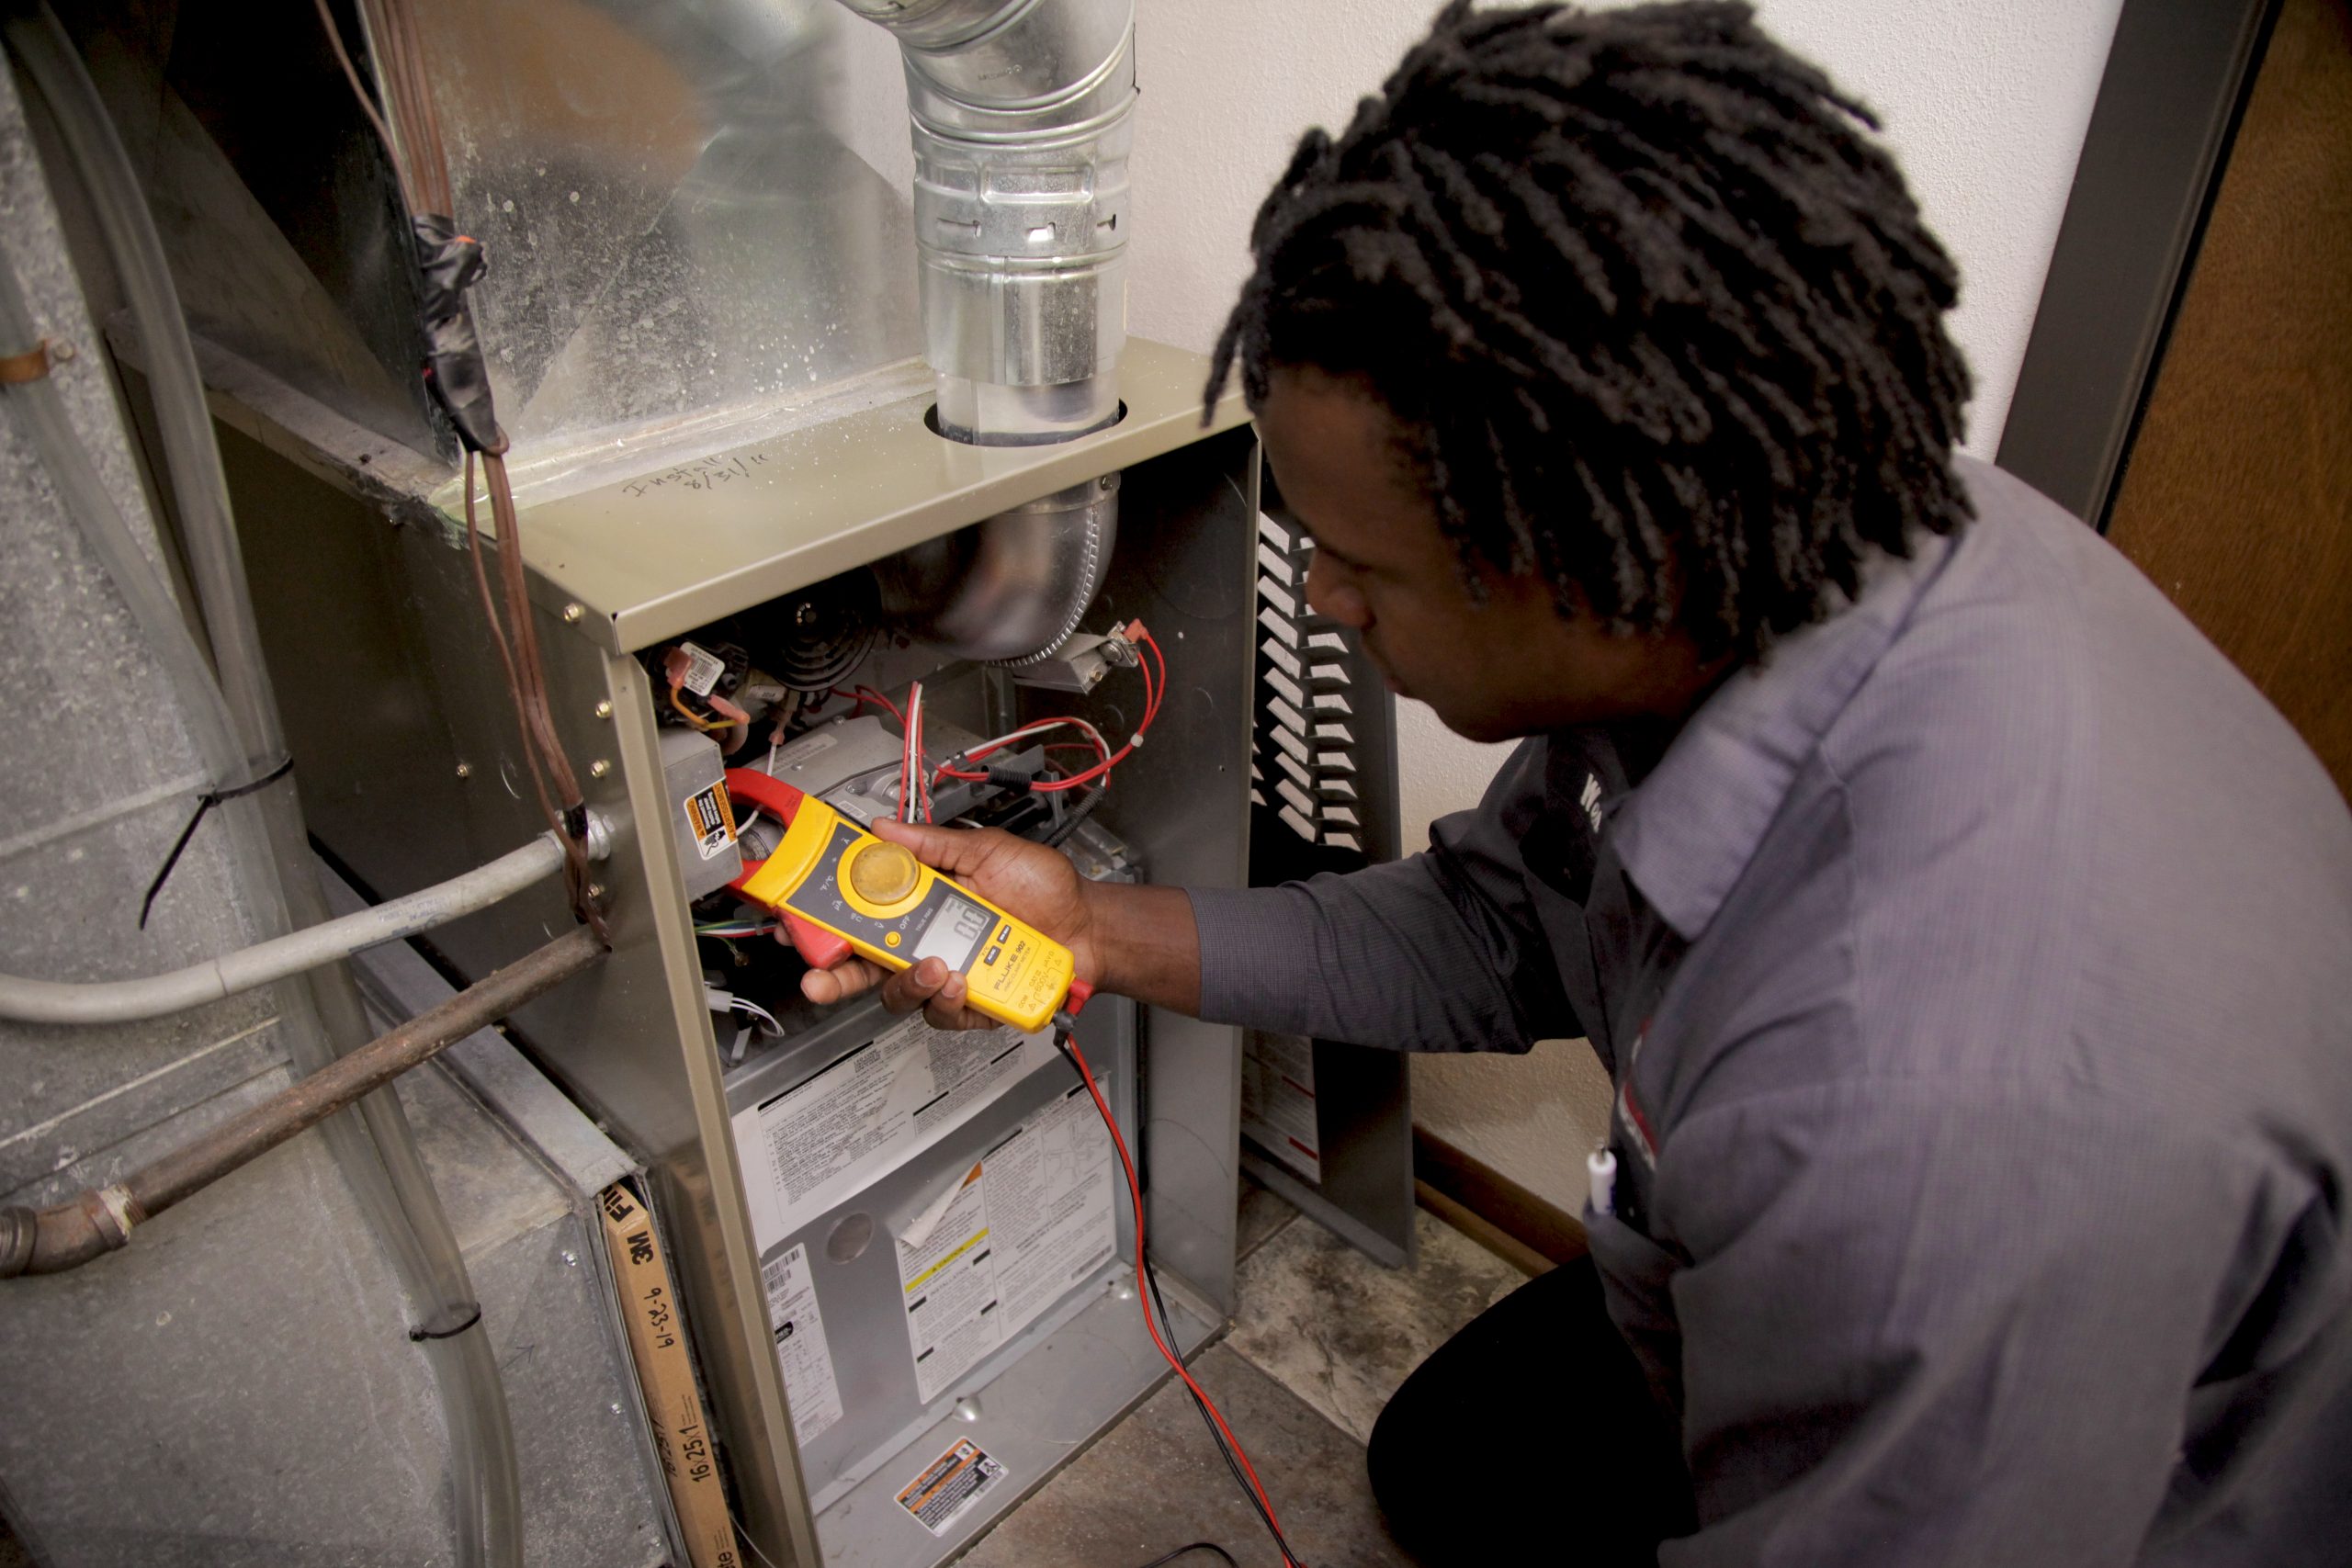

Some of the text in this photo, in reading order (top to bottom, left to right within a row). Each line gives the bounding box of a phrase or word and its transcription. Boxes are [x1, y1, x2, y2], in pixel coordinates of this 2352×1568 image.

[899, 915, 911, 931] OFF
[994, 940, 1026, 991] FLUKE 902
[627, 1231, 654, 1266] 3M
[643, 1287, 674, 1348] 9-23-19
[679, 1425, 711, 1483] 16x25x1
